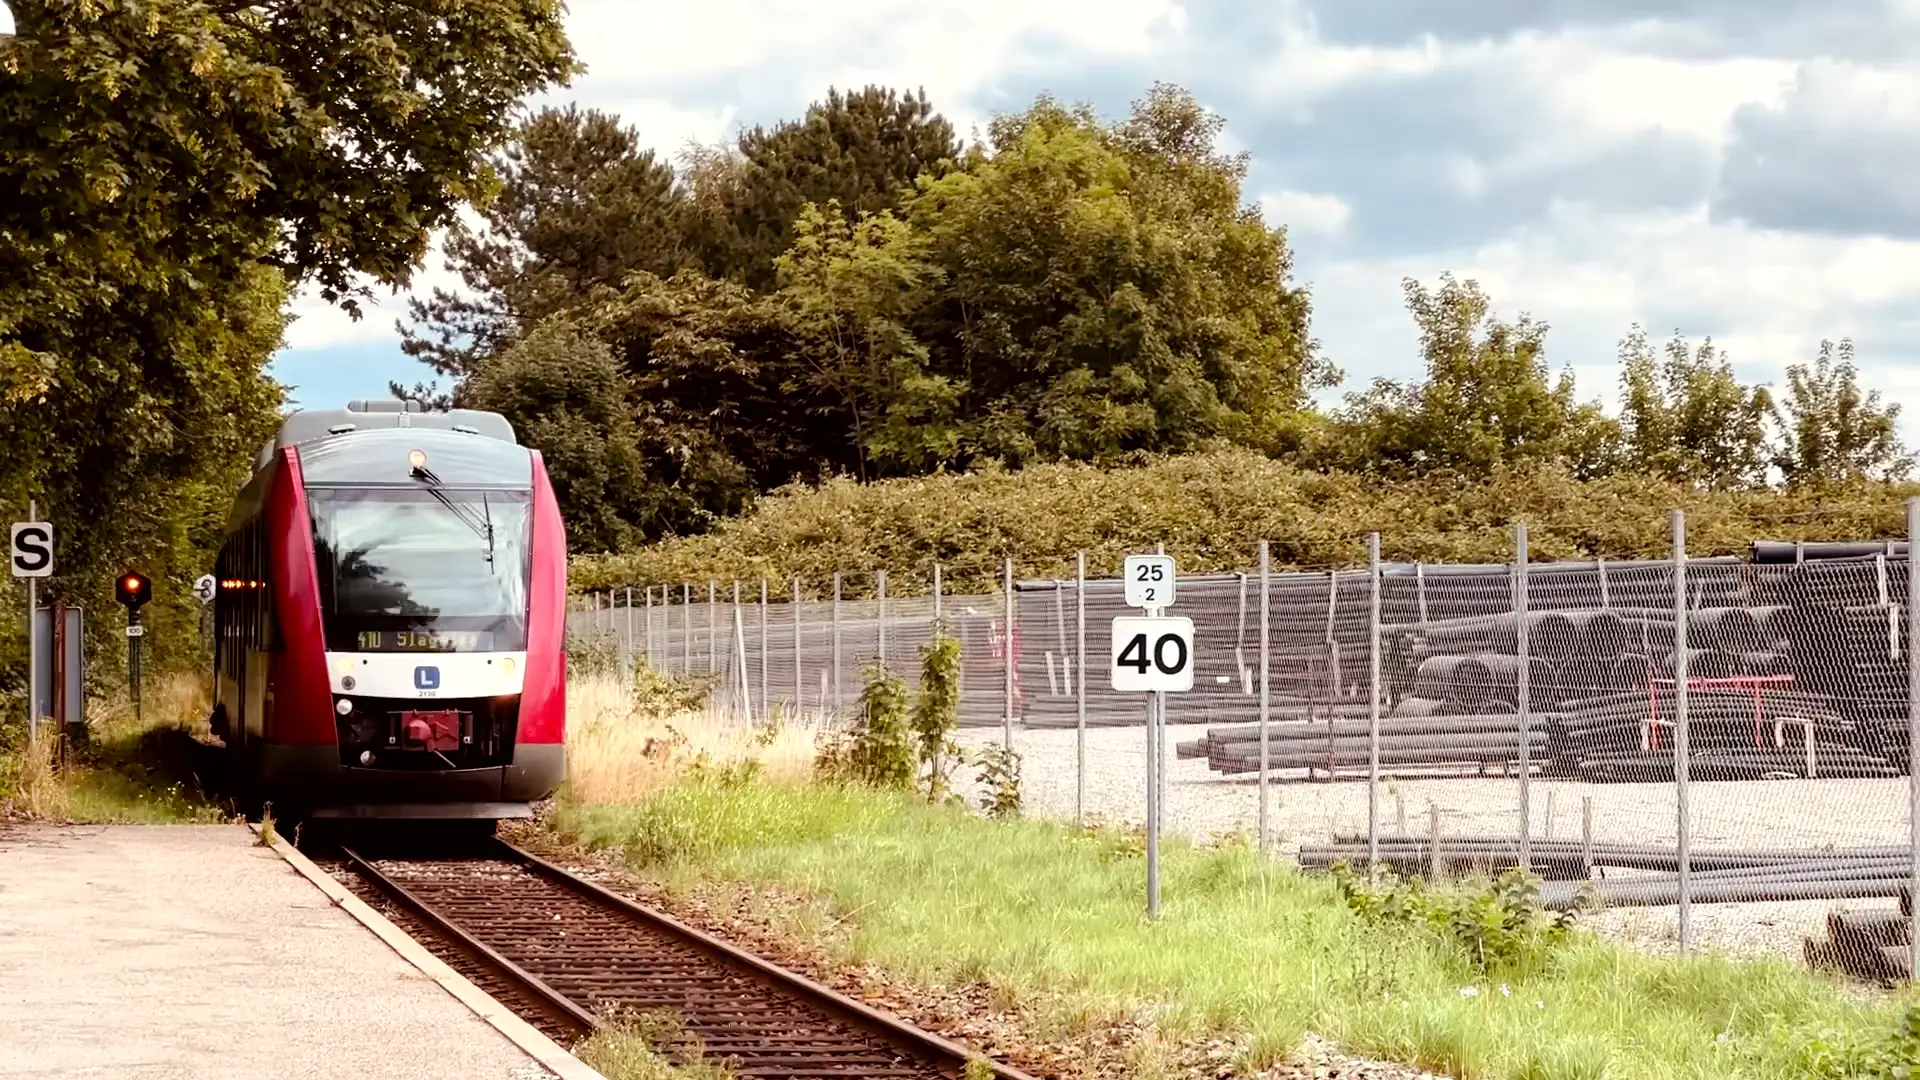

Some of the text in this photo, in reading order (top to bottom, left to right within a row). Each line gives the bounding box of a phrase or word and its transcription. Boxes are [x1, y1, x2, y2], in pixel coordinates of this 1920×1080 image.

[15, 527, 50, 571] S
[1136, 564, 1164, 582] 25
[1145, 587, 1156, 601] 2
[1117, 632, 1188, 675] 40
[421, 670, 434, 685] L
